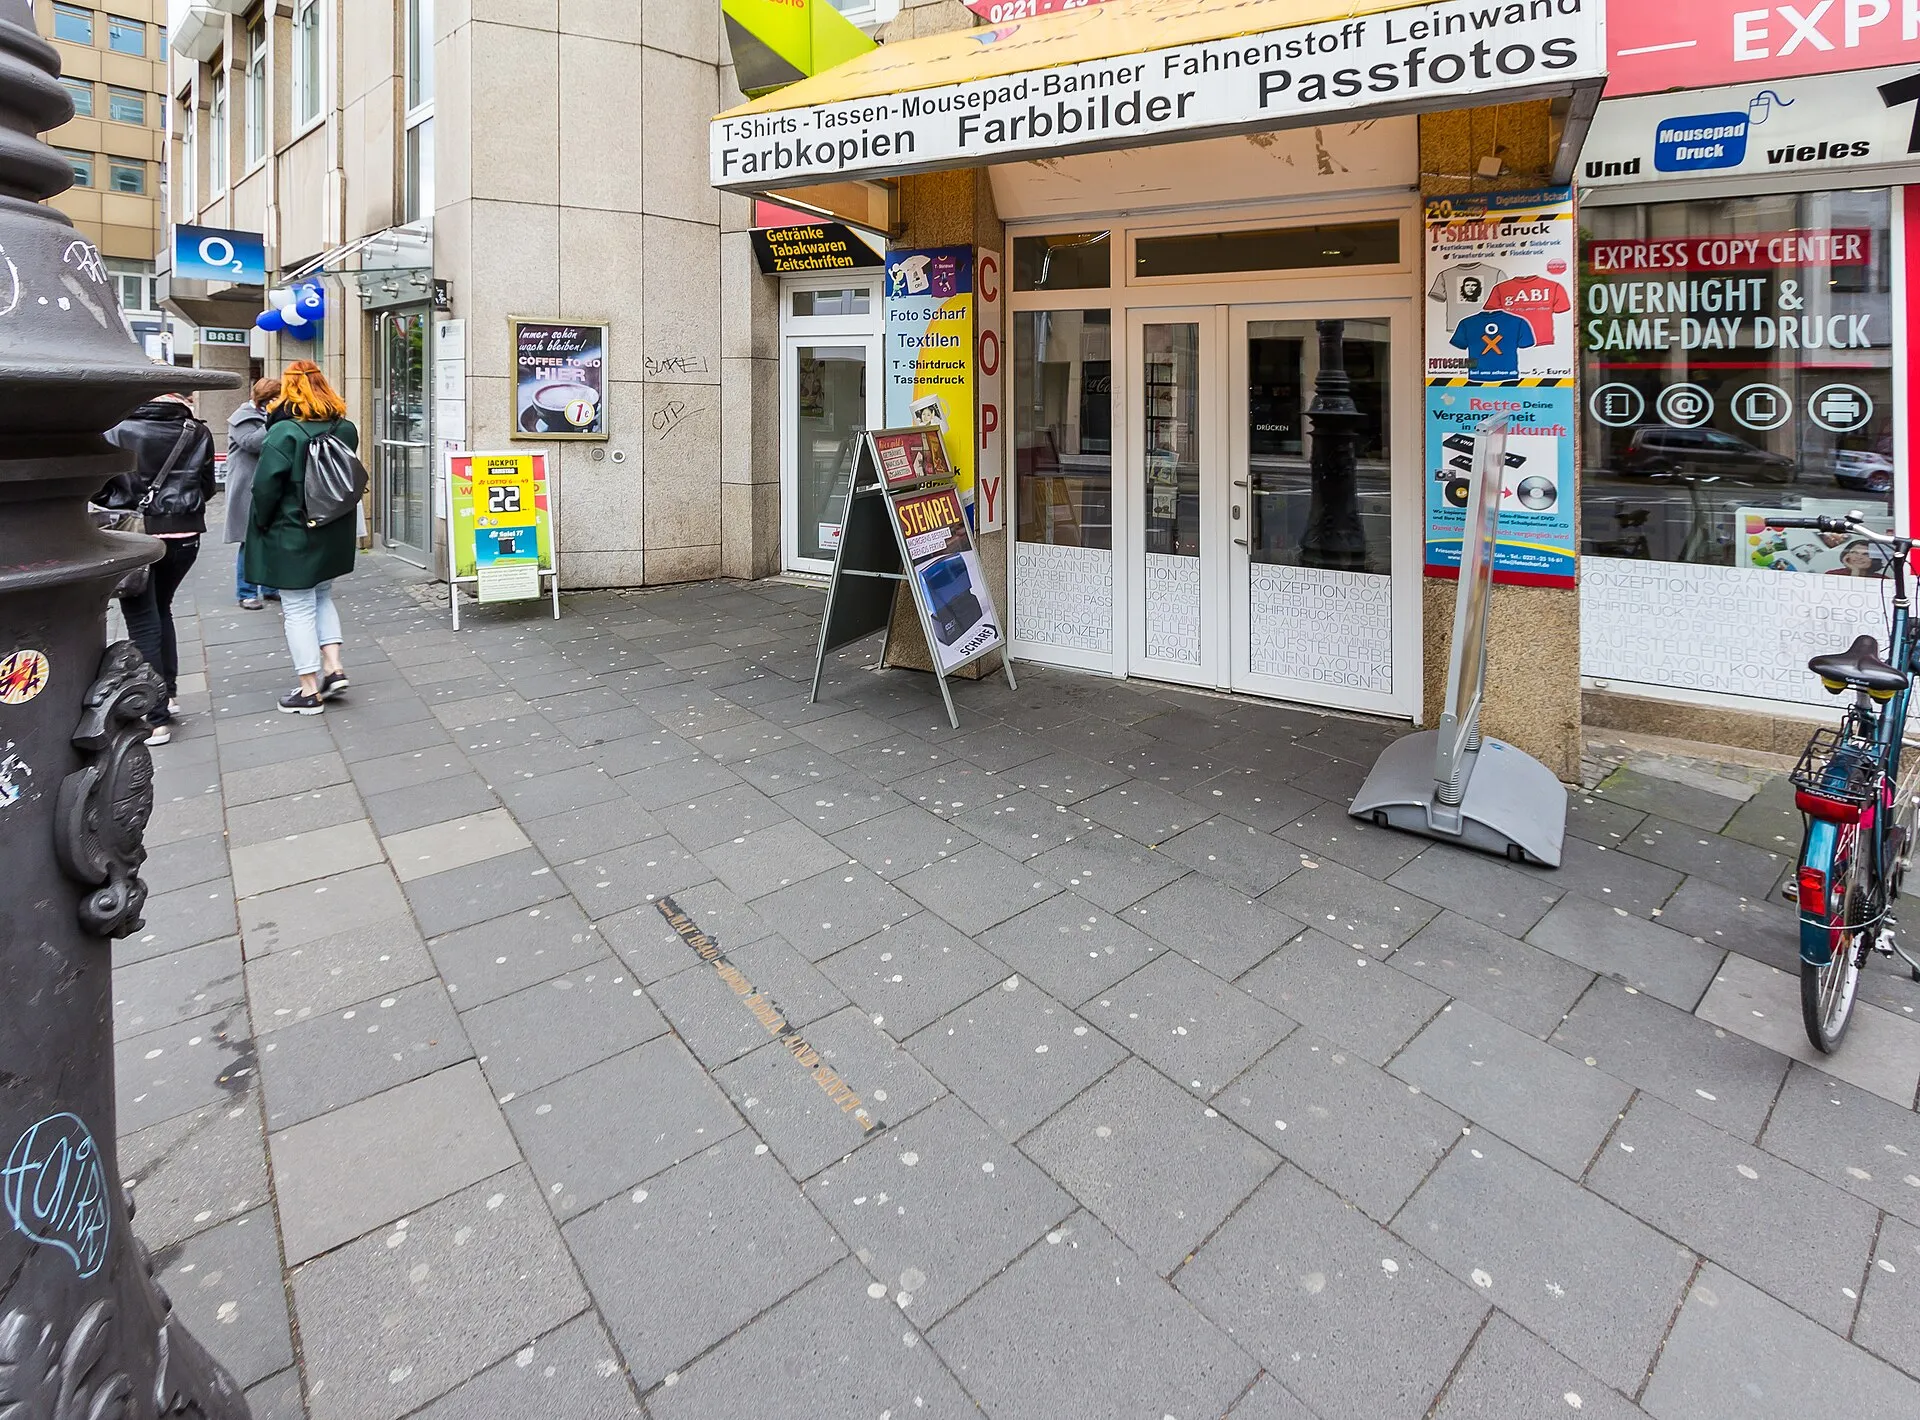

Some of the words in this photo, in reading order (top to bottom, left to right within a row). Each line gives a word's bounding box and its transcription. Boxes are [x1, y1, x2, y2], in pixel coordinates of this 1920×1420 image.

[990, 0, 1036, 24] 0221
[723, 115, 797, 142] T-Shirts
[1164, 21, 1366, 79] Fahnenstoff
[1386, 0, 1581, 45] Leinwand
[721, 129, 915, 177] Farbkopien
[959, 89, 1196, 147] Farbbilder
[1259, 37, 1578, 108] Passfotos
[1659, 122, 1745, 144] Mousepad
[1675, 143, 1724, 161] Druck
[1767, 141, 1870, 164] vieles
[1586, 157, 1640, 179] Und
[1543, 190, 1569, 203] Scharf
[766, 226, 824, 242] Getränke
[1501, 222, 1550, 237] druck
[770, 240, 846, 257] Tabakwaren
[1594, 242, 1689, 270] EXPRESS
[1697, 239, 1760, 266] COPY
[1767, 234, 1862, 263] CENTER
[774, 255, 853, 271] Zeitschriften
[1504, 286, 1550, 306] gABI
[1588, 278, 1767, 315] OVERNIGHT
[1777, 279, 1804, 312] &
[890, 309, 919, 321] Foto
[923, 307, 966, 320] Scharf
[208, 331, 243, 342] BASE
[519, 327, 548, 339] Immer
[552, 328, 577, 339] schön
[898, 332, 960, 348] Textilen
[1587, 316, 1743, 351] SAME-DAY
[1754, 314, 1872, 349] DRUCK
[519, 339, 544, 351] wach
[547, 339, 584, 351] bleiben!
[519, 356, 563, 367] COFFEE
[566, 358, 585, 367] TO
[586, 359, 601, 368] GO
[909, 360, 965, 369] Shirtdruck
[535, 367, 586, 382] HIER
[894, 375, 965, 384] Tassendruck
[575, 403, 583, 422] 1
[1470, 398, 1521, 411] Rette
[1523, 401, 1553, 409] Deine
[1256, 423, 1289, 432] DRÜCKEN
[1508, 423, 1566, 437] ukunft
[487, 459, 518, 467] JACKPOT
[489, 486, 520, 512] 22
[899, 495, 960, 536] STEMPEL
[1251, 578, 1347, 599] KONZEPTION
[1581, 572, 1699, 594] KONZEPTION
[960, 627, 993, 656] SCHARF
[1312, 668, 1370, 688] DESIGN
[1657, 668, 1729, 689] DESIGN
